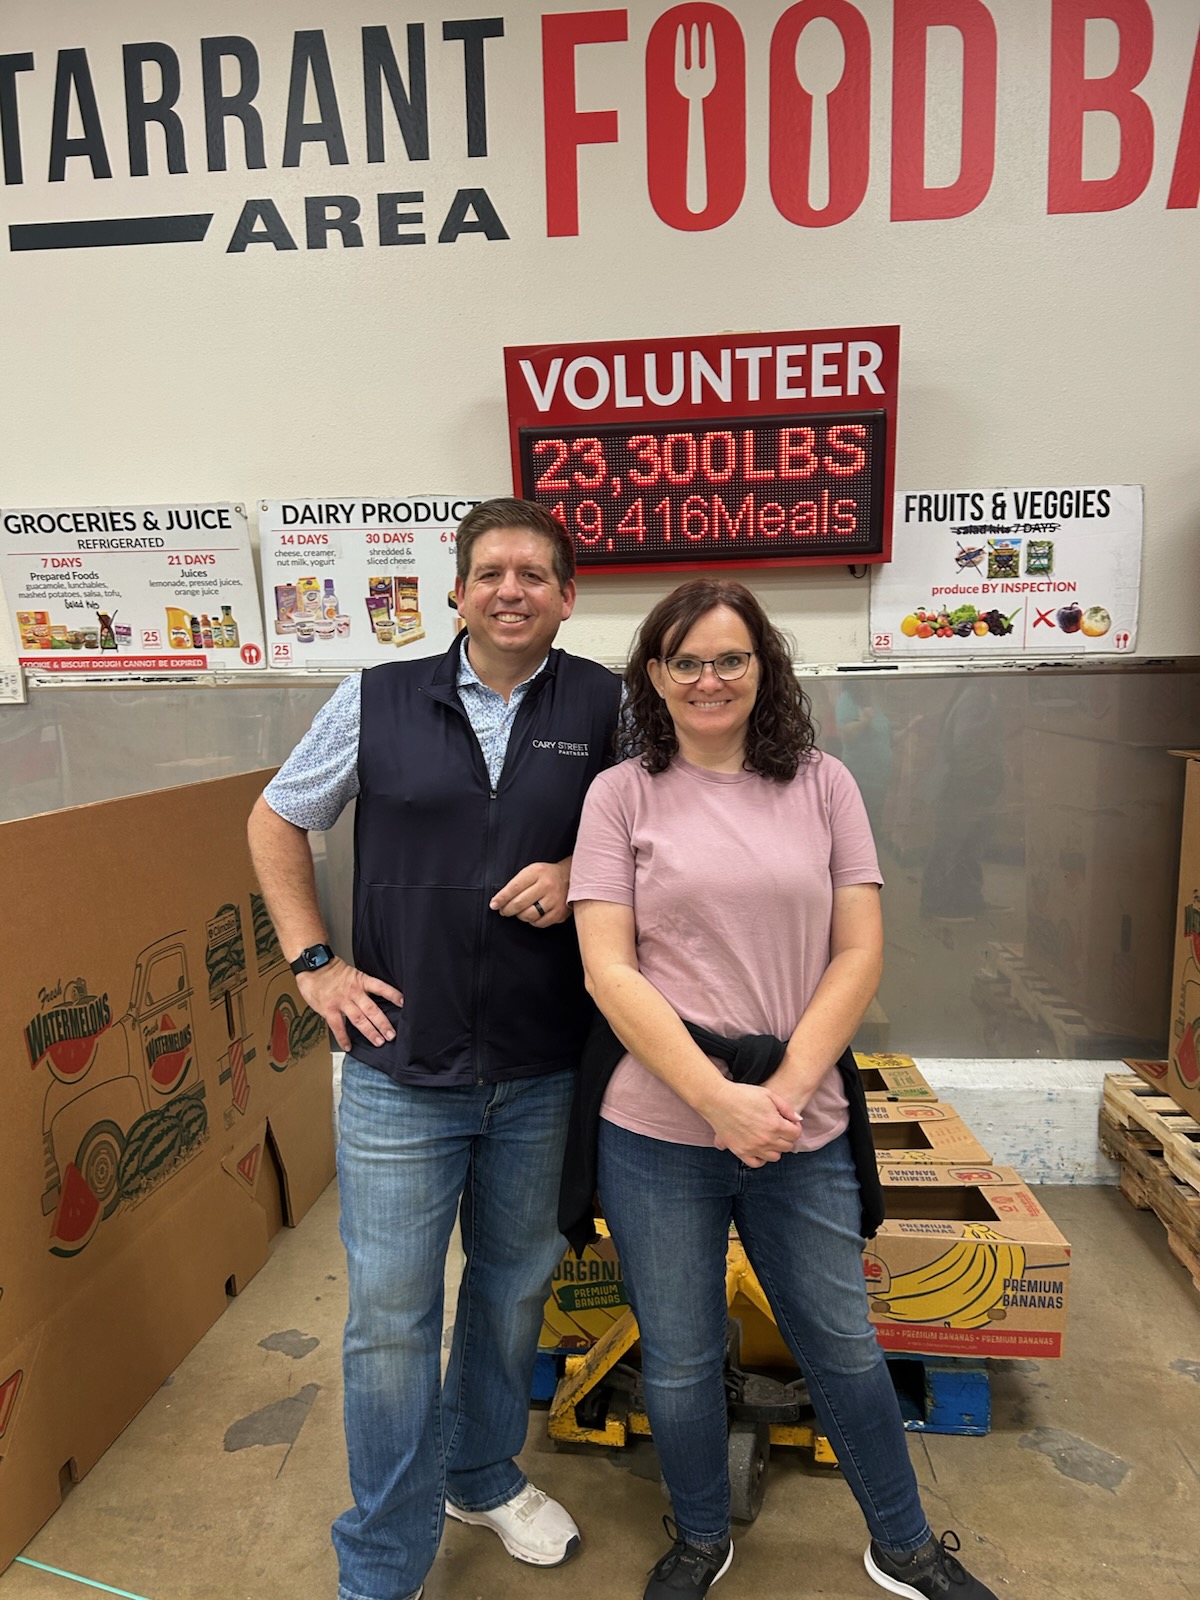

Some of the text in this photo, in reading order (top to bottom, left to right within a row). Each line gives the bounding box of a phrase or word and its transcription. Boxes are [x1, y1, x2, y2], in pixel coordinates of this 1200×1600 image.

[0, 17, 505, 186] TARRANT
[540, 0, 998, 238] FOOD
[225, 187, 511, 254] AREA
[518, 341, 886, 412] VOLUNTEER
[532, 423, 868, 497] 23,300LBS
[904, 489, 1111, 523] FRUITS & VEGGIES
[282, 503, 356, 525] DAIRY
[4, 509, 232, 535] GROCERIES & JUICE
[77, 537, 165, 550] REFRIGERATED
[280, 534, 329, 545] 14 DAYS
[365, 532, 415, 544] 30 DAYS
[440, 532, 447, 543] 6
[369, 547, 412, 556] shredded &
[41, 557, 83, 568] 7 DAYS
[167, 554, 216, 566] 21 DAYS
[310, 559, 336, 568] yogurt
[366, 557, 416, 565] sliced cheese
[30, 571, 100, 582] Prepared Foods
[180, 569, 208, 578] Juices
[189, 579, 218, 588] pressed
[931, 581, 1077, 597] produce BY INSPECTION
[18, 591, 47, 599] mashed
[174, 587, 219, 597] orange juice
[143, 631, 159, 642] 25
[875, 635, 890, 646] 25
[274, 645, 289, 656] 25
[52, 661, 60, 669] &
[61, 660, 92, 669] BISCUIT
[92, 660, 121, 668] DOUGH
[122, 660, 156, 668] CANNOT
[170, 659, 204, 667] EXPIRED
[532, 739, 589, 751] CARY STREET
[25, 992, 111, 1066] WATERMELONS
[146, 1023, 192, 1070] WATERMELONS
[955, 1172, 993, 1181] Dole
[574, 1284, 619, 1298] PREMIUM
[1003, 1278, 1064, 1294] PREMIUM
[574, 1294, 621, 1309] BANANAS
[1002, 1294, 1064, 1310] BANANAS
[902, 1329, 939, 1340] PREMIUM
[938, 1332, 975, 1343] BANANAS
[981, 1335, 1017, 1345] PREMIUM
[1017, 1336, 1054, 1346] BANANAS
